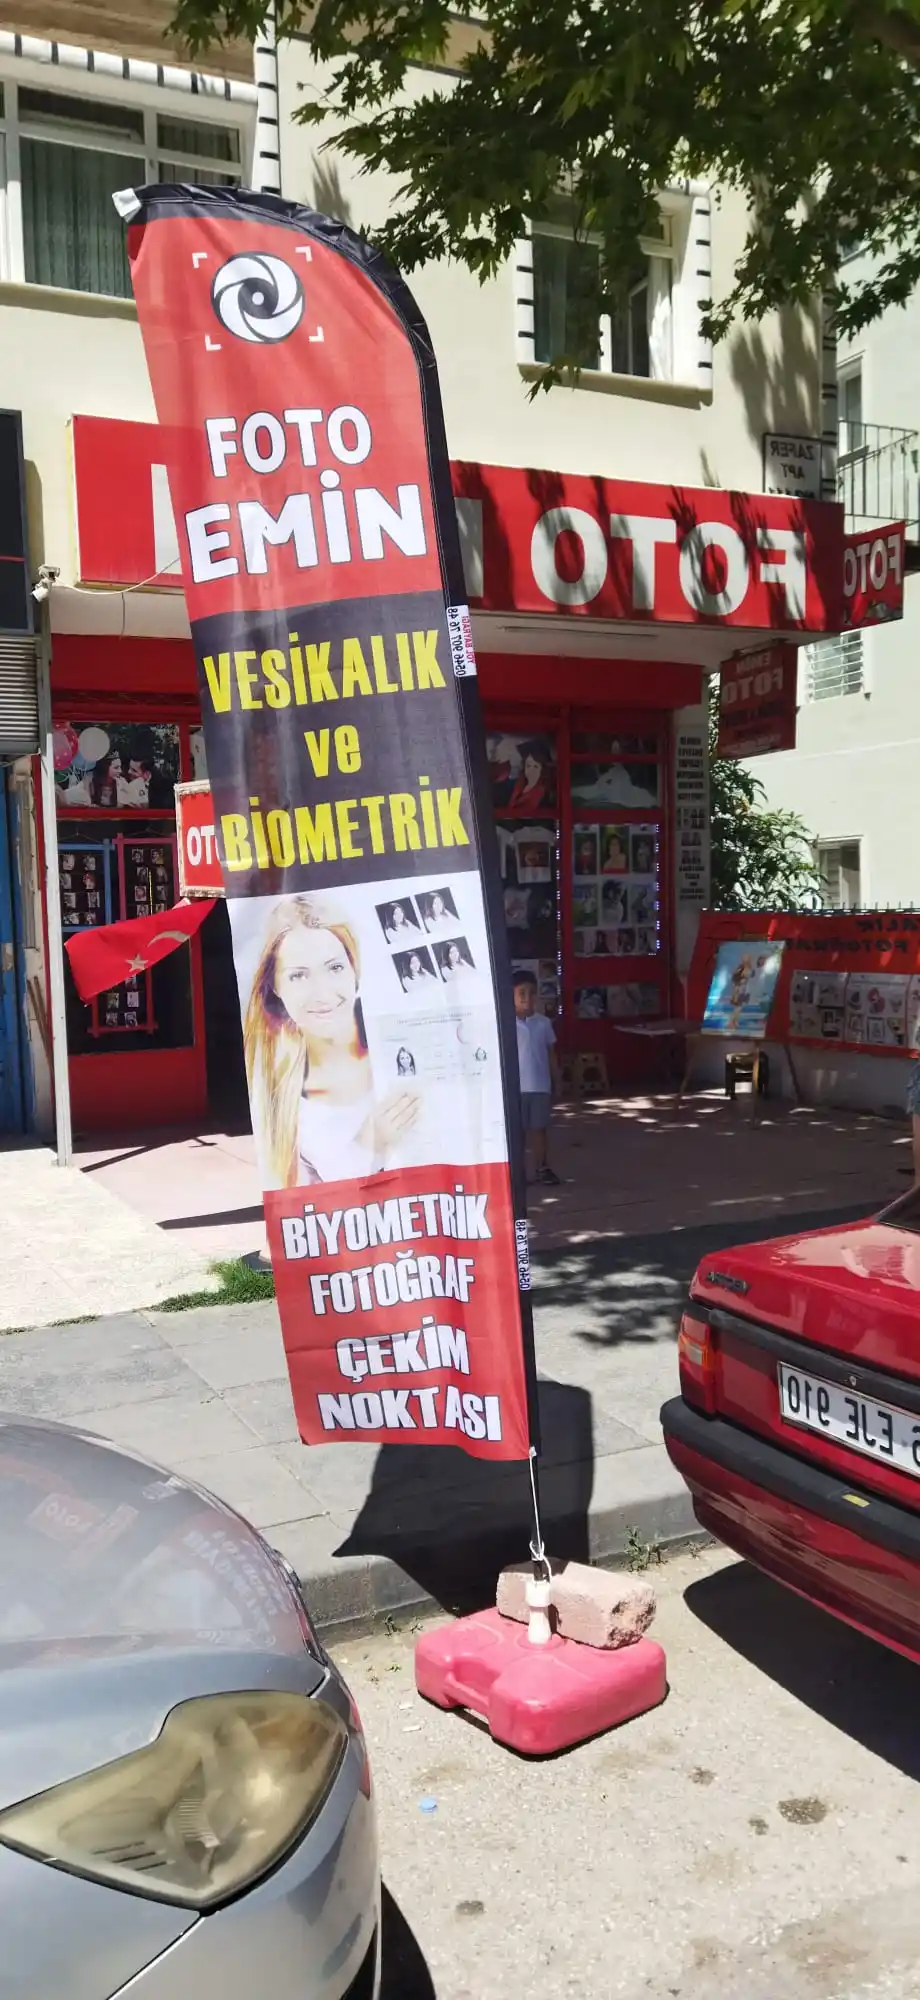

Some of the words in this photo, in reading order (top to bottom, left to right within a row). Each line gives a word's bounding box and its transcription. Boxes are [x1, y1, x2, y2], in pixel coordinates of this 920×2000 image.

[205, 405, 372, 478] FOTO
[184, 469, 428, 585] EMİN
[203, 630, 445, 713] VESİKALIK
[304, 725, 361, 778] ve
[220, 775, 468, 870] BİOMETRİK
[281, 1184, 492, 1260] BİYOMETRİK
[310, 1249, 475, 1315] FOTOĞRAF
[336, 1315, 471, 1382] ÇEKİM
[317, 1386, 502, 1441] NOKTASI
